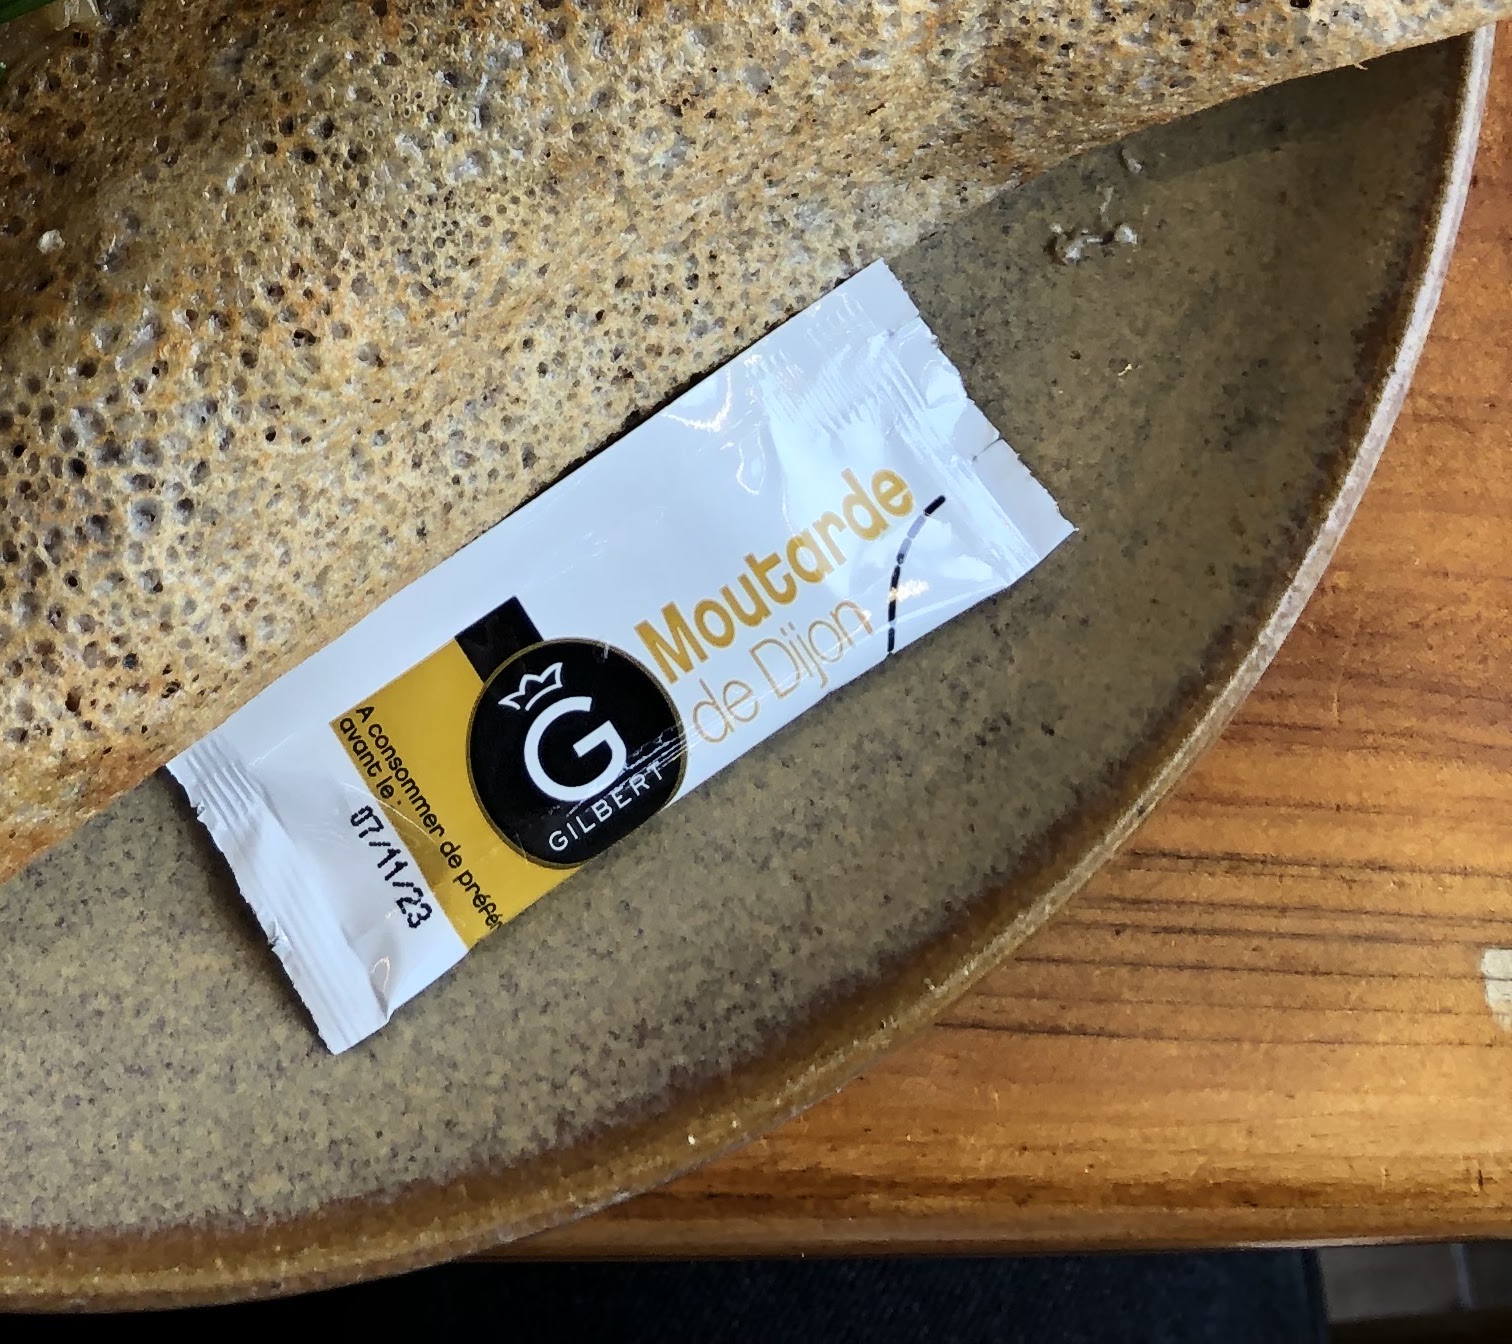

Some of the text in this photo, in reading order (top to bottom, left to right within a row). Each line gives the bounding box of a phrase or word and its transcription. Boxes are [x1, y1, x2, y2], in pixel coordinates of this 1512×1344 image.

[634, 467, 915, 685] Moutarde
[692, 600, 874, 744] de Dijon
[339, 717, 382, 778] avant
[356, 706, 375, 723] A
[368, 723, 445, 838] consommer
[439, 840, 463, 870] de
[524, 696, 627, 802] G
[548, 761, 663, 851] GILBERT
[351, 805, 433, 928] 07/11/23
